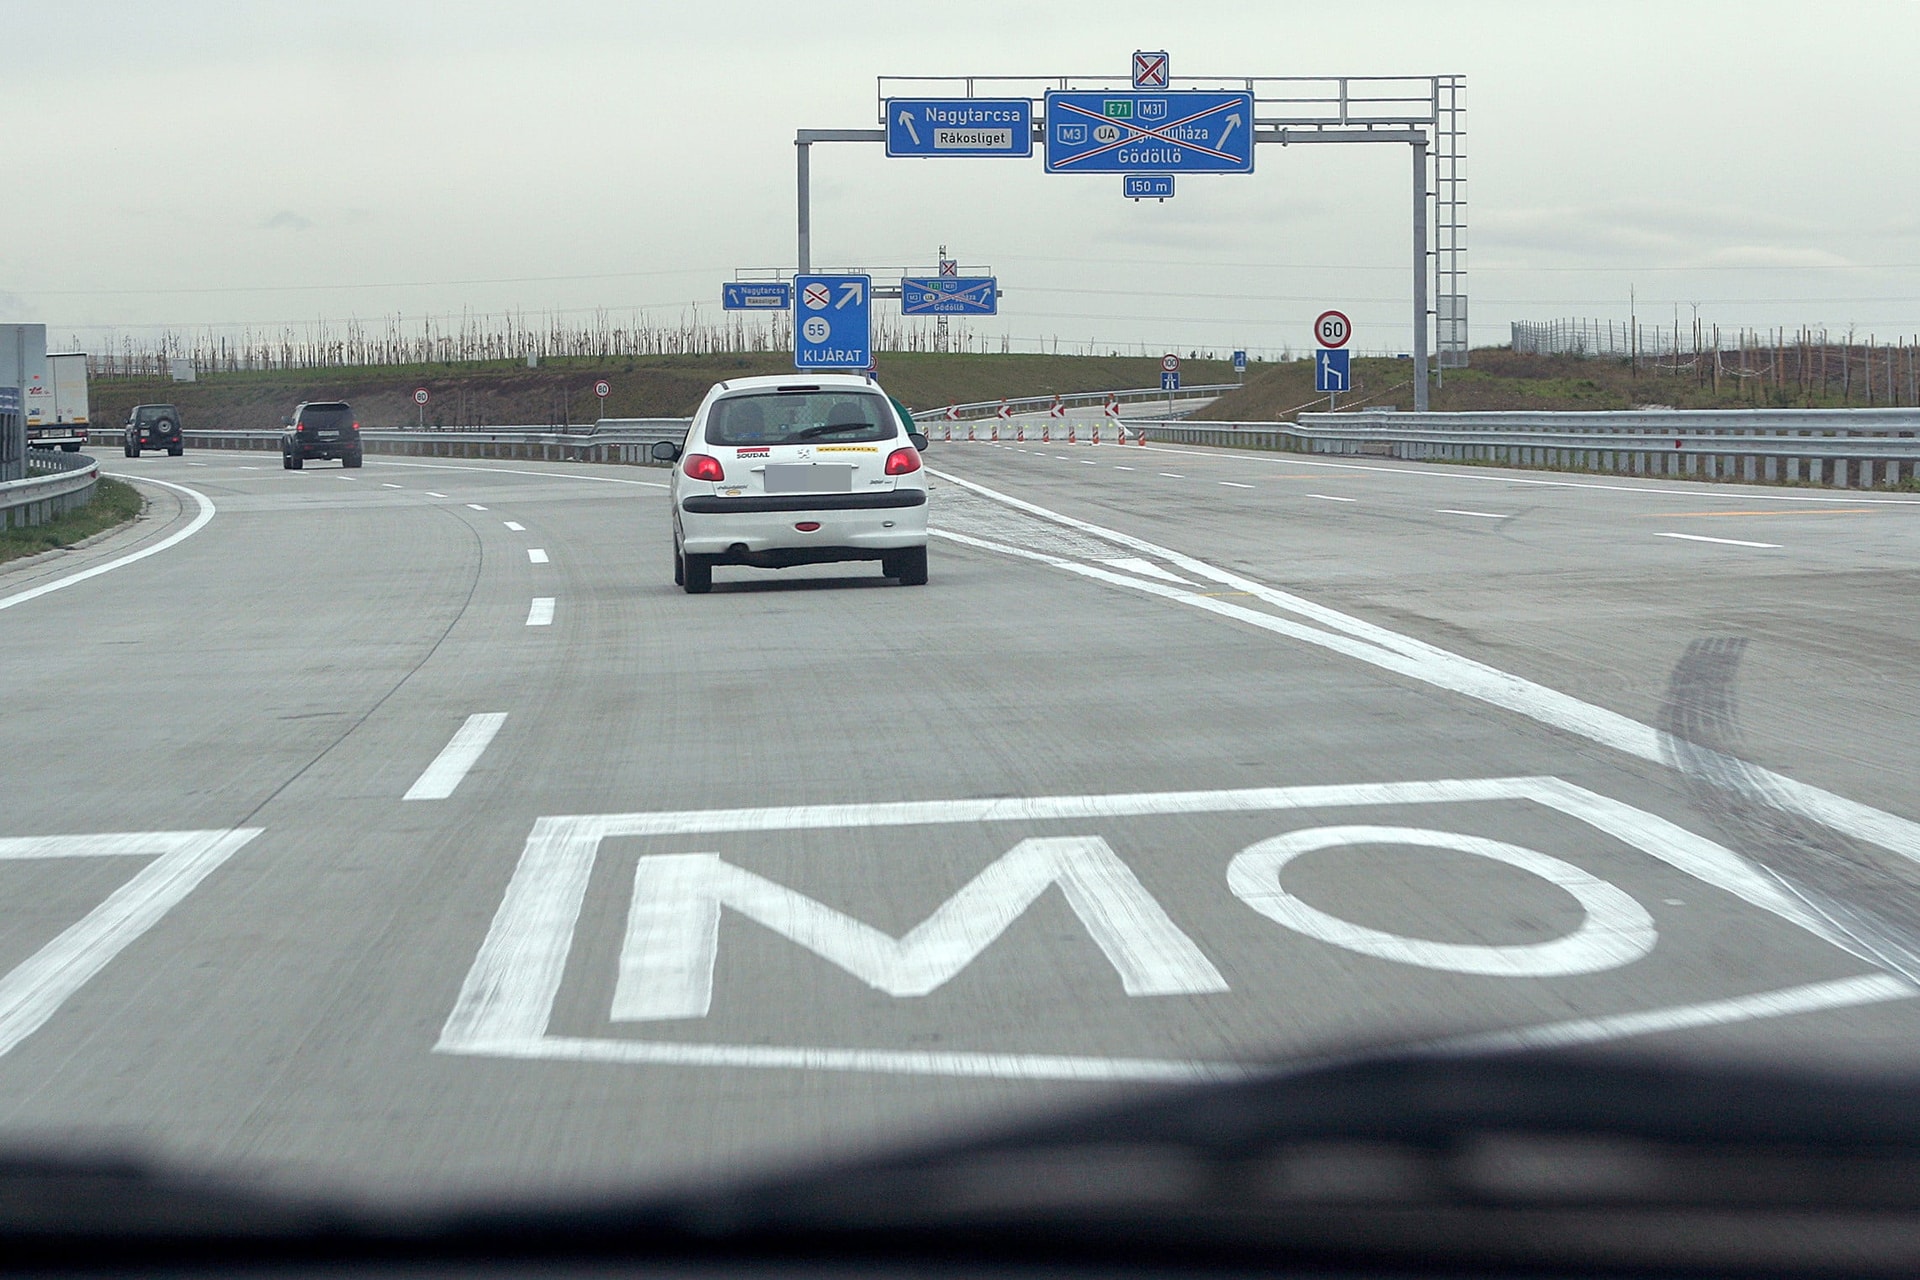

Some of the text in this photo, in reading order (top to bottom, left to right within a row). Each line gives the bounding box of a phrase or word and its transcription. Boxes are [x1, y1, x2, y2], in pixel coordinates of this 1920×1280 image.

[1109, 103, 1128, 115] E71
[1143, 103, 1162, 115] M31
[926, 107, 1020, 125] Nagytarcsa
[940, 132, 1005, 146] Rákosliget
[1063, 128, 1081, 140] M3
[1098, 128, 1116, 140] UA
[1131, 181, 1168, 192] 150 m
[808, 324, 825, 336] 55
[1323, 321, 1343, 338] 60
[803, 347, 862, 362] KIJÁRAT
[1164, 358, 1176, 367] 100
